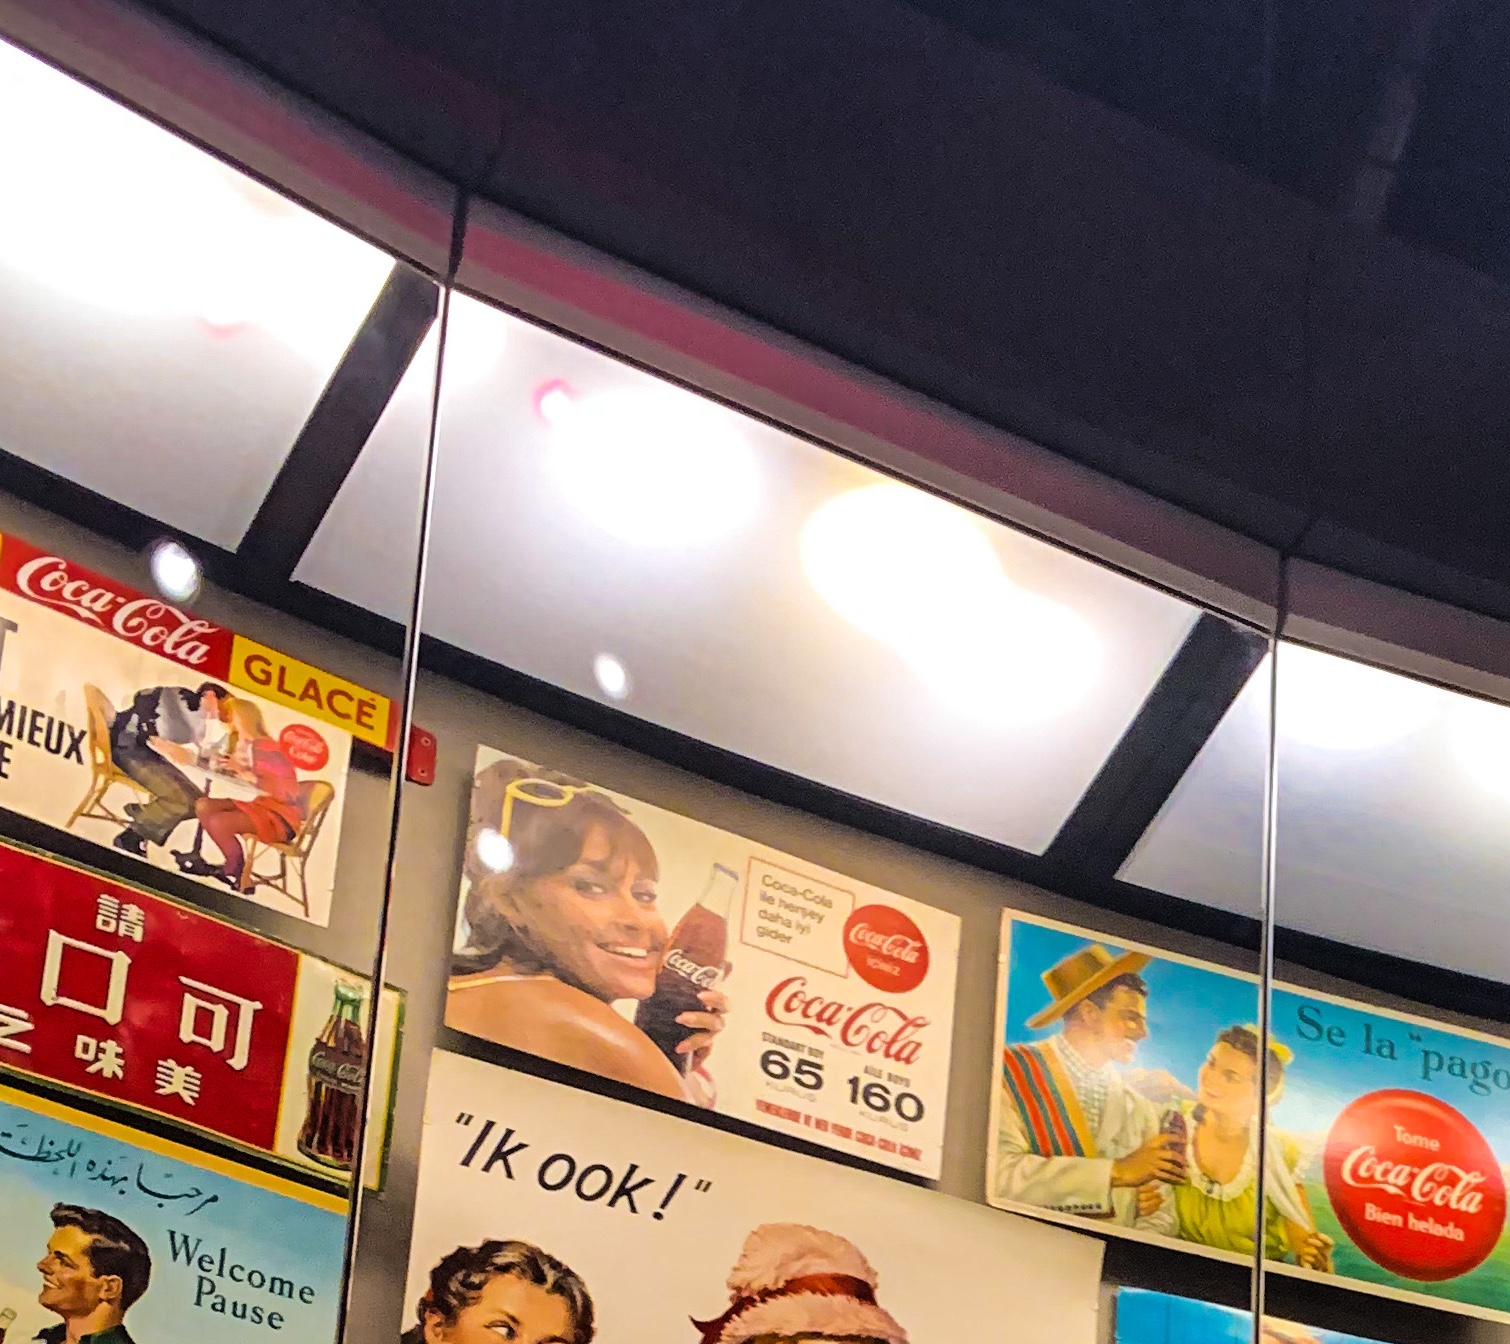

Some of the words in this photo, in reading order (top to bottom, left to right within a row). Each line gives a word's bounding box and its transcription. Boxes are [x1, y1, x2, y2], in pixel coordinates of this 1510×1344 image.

[16, 555, 218, 667] Coca-Cola
[243, 653, 379, 732] GLACÉ
[849, 922, 924, 965] Coca-Cola
[765, 976, 931, 1066] Coca-Cola
[1295, 1005, 1346, 1047] Se
[1363, 1023, 1398, 1062] la
[759, 1049, 825, 1091] 65
[847, 1075, 925, 1123] 160
[1393, 1124, 1441, 1153] Tome
[1341, 1145, 1487, 1216] Coca-Cola
[1363, 1203, 1404, 1229] Bien
[1406, 1216, 1466, 1243] helada
[167, 1228, 316, 1305] Welcome
[193, 1274, 286, 1331] Pause
